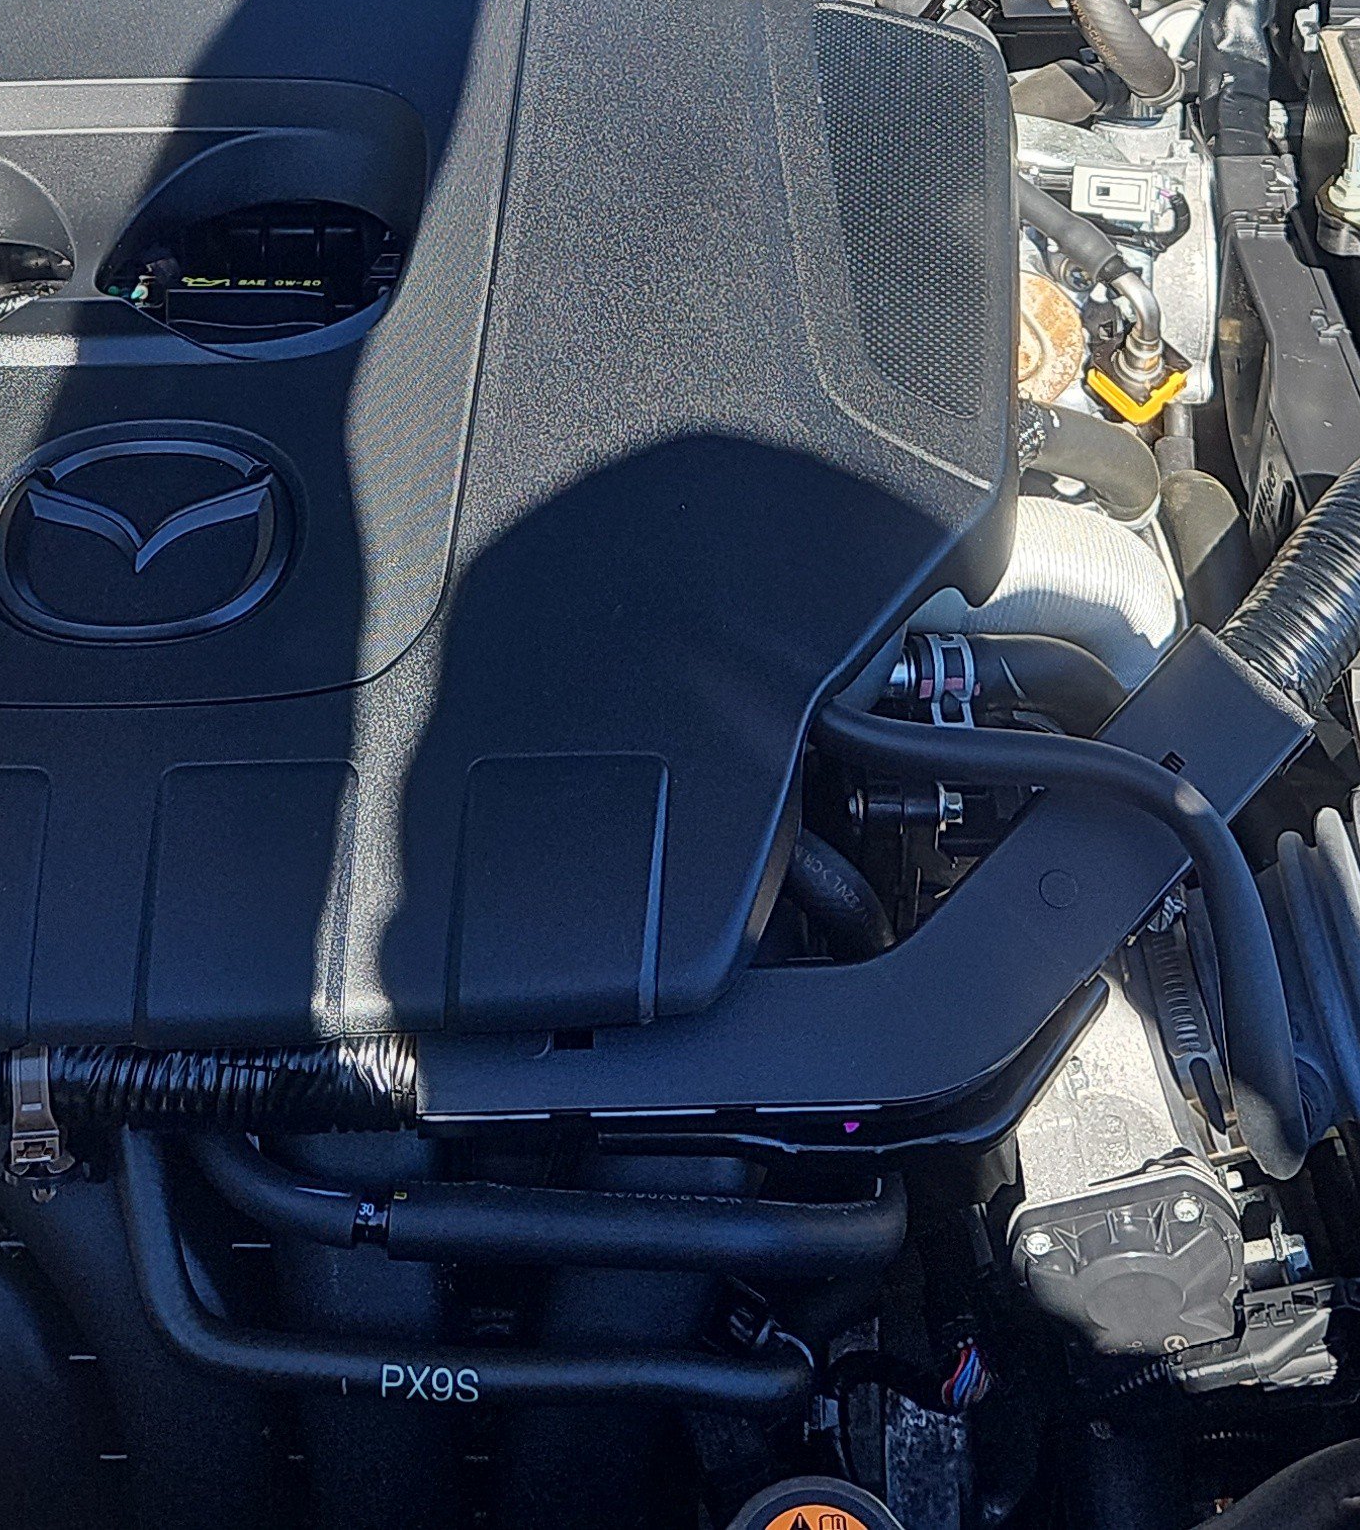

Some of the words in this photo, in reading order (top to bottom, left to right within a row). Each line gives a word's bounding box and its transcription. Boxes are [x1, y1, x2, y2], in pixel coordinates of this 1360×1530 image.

[238, 278, 267, 286] SAE
[274, 279, 322, 287] 0W-20
[358, 1202, 375, 1217] 30
[380, 1363, 480, 1403] PX9S
